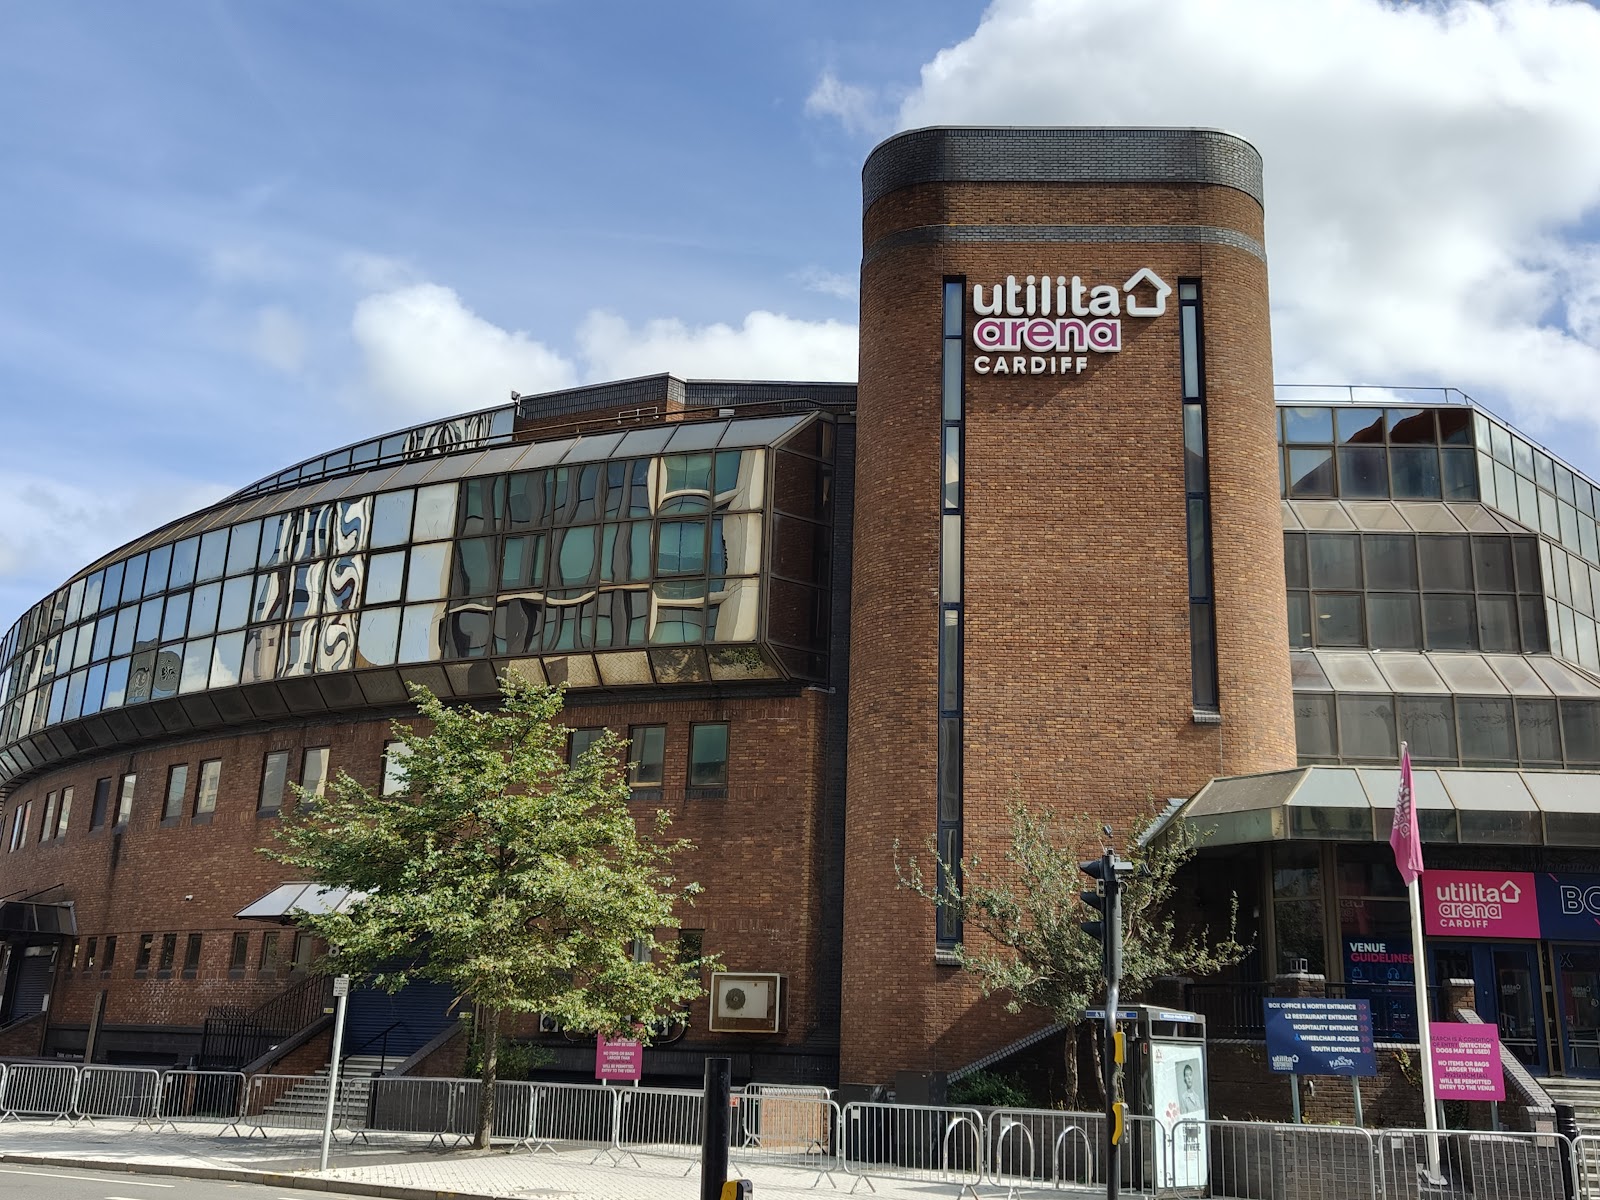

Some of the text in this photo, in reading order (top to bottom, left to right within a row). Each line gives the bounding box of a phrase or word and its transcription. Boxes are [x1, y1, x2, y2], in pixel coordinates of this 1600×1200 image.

[974, 275, 1120, 316] utilita
[973, 318, 1121, 352] arena
[974, 356, 1088, 374] CARDIFF
[1436, 882, 1500, 902] utilita
[1438, 902, 1502, 919] arena
[1440, 919, 1488, 928] CARDIFF
[1350, 943, 1386, 952] VENUE
[1351, 953, 1414, 963] GUIDELINES
